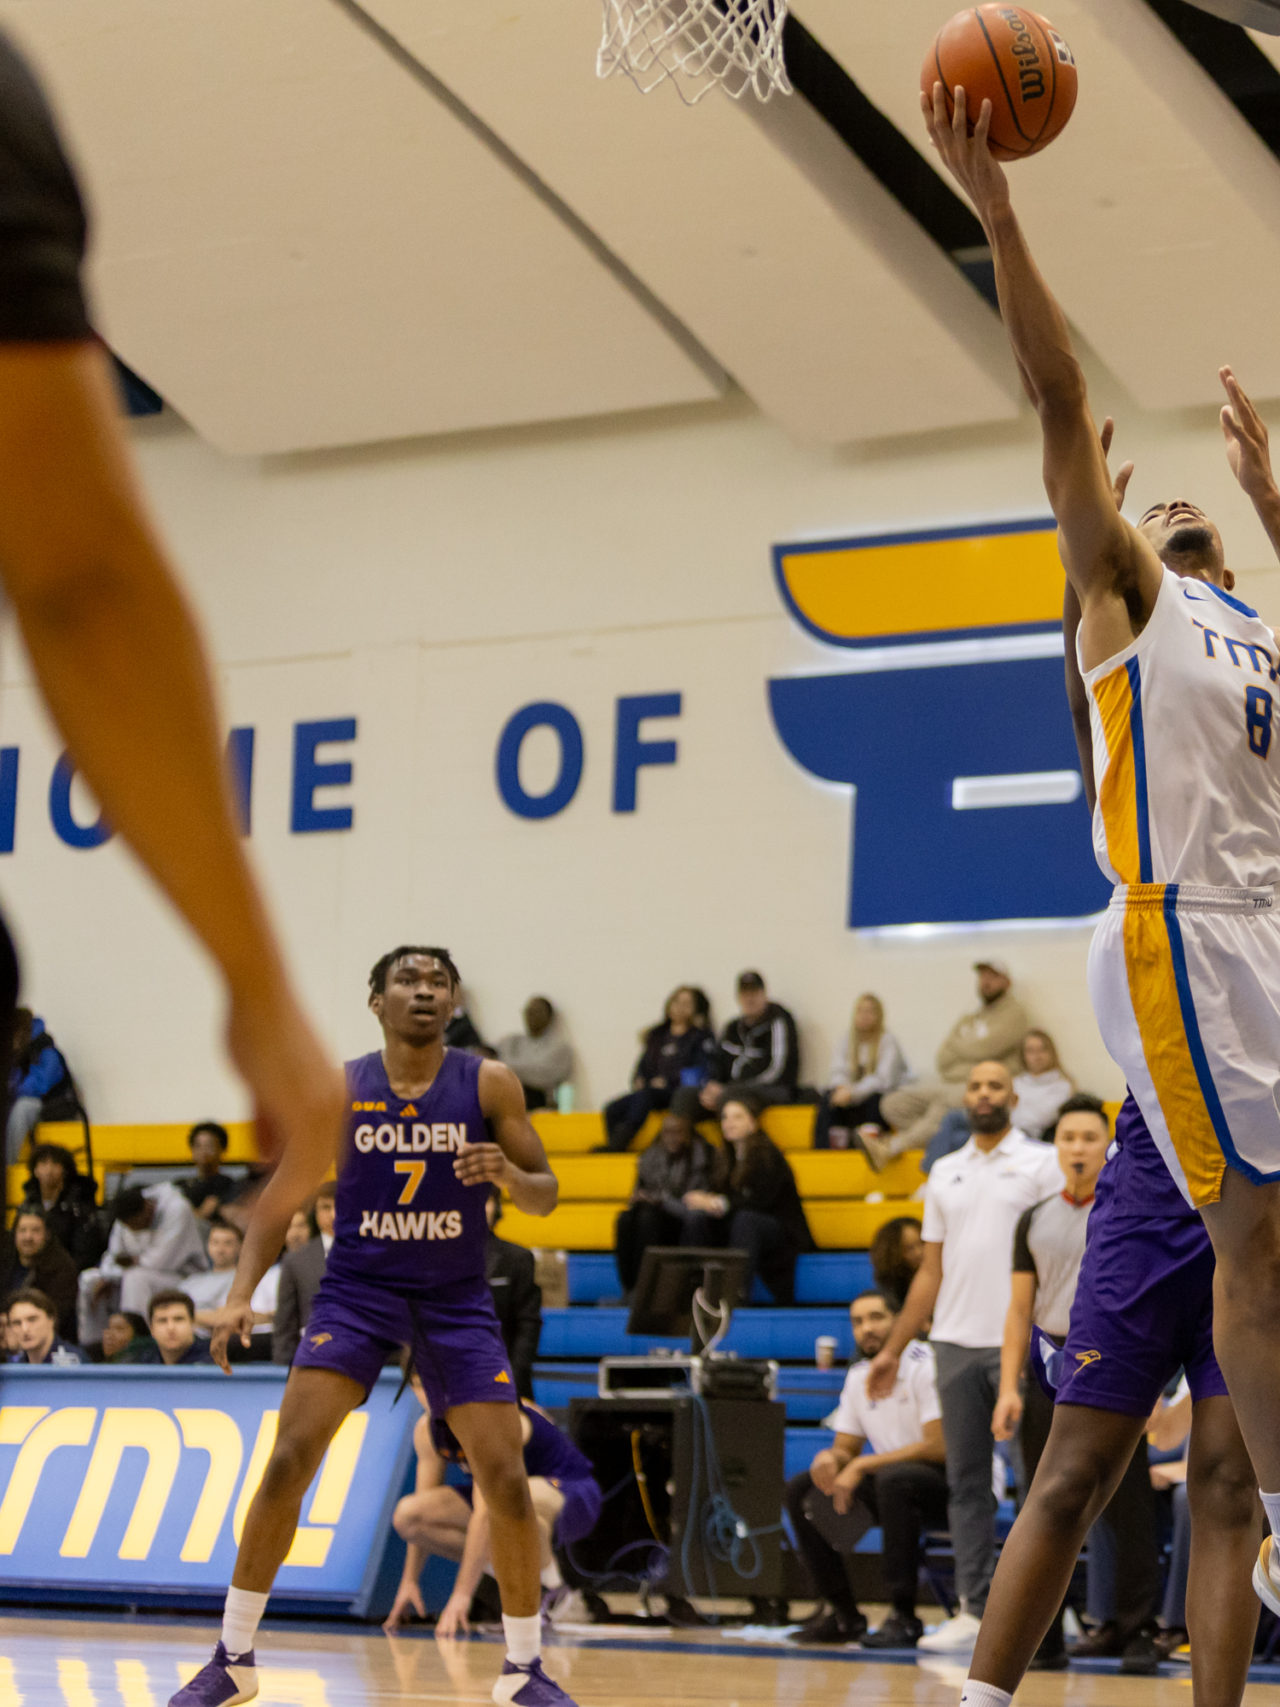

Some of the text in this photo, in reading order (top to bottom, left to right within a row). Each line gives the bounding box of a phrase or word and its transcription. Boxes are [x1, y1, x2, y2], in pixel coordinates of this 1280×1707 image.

[997, 8, 1045, 103] Wilson
[1244, 682, 1274, 761] 8
[0, 717, 357, 854] OE
[495, 691, 683, 821] OF
[1252, 896, 1273, 909] TMU
[354, 1122, 467, 1154] GOLDEN
[394, 1159, 427, 1205] 7
[359, 1210, 463, 1241] HAWKS
